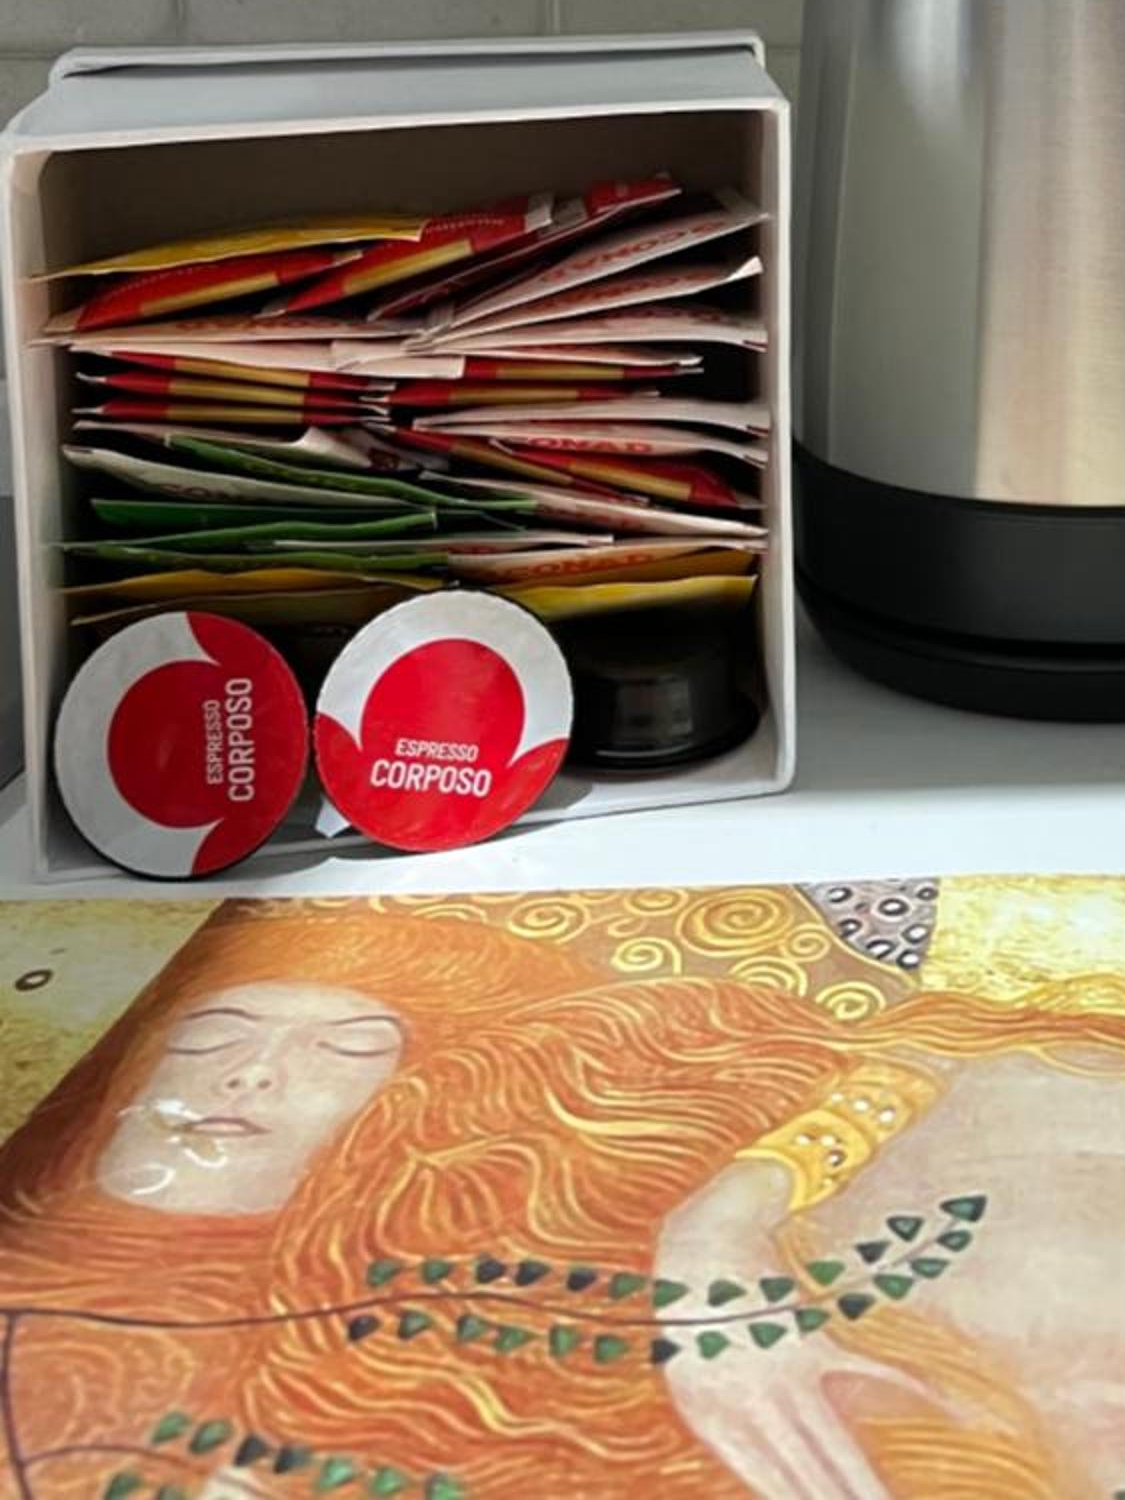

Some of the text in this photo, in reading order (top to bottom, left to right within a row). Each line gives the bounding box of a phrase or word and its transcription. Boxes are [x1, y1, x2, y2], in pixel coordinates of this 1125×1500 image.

[202, 699, 224, 784] ESPRESSO
[225, 678, 254, 801] CORPOSO
[395, 738, 479, 762] ESPRESSO
[371, 759, 492, 797] CORPOSO
